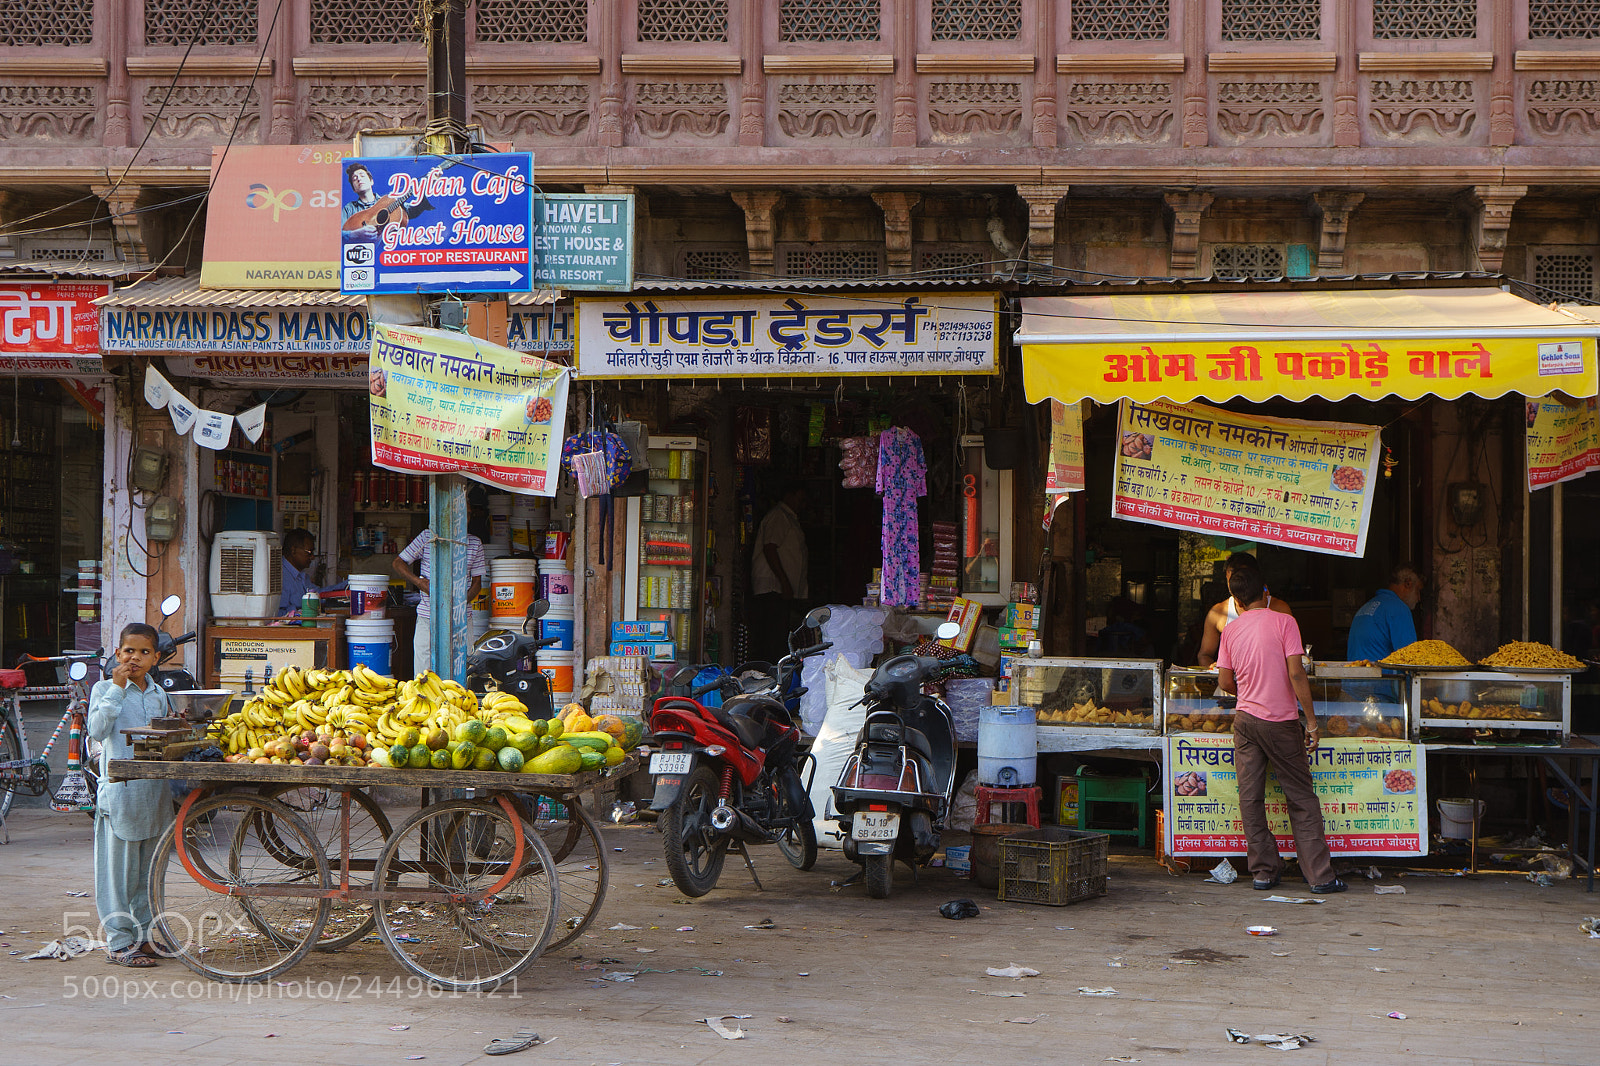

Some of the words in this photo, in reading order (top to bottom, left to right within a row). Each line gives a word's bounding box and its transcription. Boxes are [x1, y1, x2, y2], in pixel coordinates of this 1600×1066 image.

[388, 167, 467, 206] Dylan
[471, 165, 526, 204] Cafe
[451, 199, 473, 219] &
[545, 203, 618, 224] HAVELI
[382, 222, 446, 251] Guest
[449, 217, 525, 246] House
[581, 225, 592, 234] AS
[534, 236, 559, 250] EST
[564, 237, 610, 251] HOUSE
[613, 237, 624, 251] &
[384, 252, 416, 264] ROOF
[421, 252, 443, 263] TOP
[446, 251, 527, 263] RESTAURANT
[544, 255, 618, 266] RESTAURANT
[246, 270, 304, 280] NARAYAN
[307, 270, 333, 280] DAS
[534, 270, 556, 280] AGA
[560, 270, 603, 281] RESORT
[107, 311, 207, 340] NARAYAN
[212, 311, 271, 341] DASS
[769, 297, 928, 351] ट्रेडर्स
[106, 340, 117, 348] 17
[120, 340, 137, 348] PAL
[138, 340, 164, 348] HOUSE
[166, 341, 217, 350] GULABSAGAR
[286, 341, 303, 350] ALL
[304, 341, 331, 350] KINDS
[333, 341, 345, 350] OF
[736, 348, 748, 366] के
[844, 351, 867, 364] पाल
[1103, 346, 1198, 383] ओम
[1206, 346, 1264, 382] जी
[1274, 342, 1390, 387] पकोड़े
[1407, 342, 1493, 379] वाले
[1129, 401, 1214, 439] सिखवाल
[1217, 422, 1289, 451] नमकीन
[1348, 443, 1367, 462] वाले
[1189, 440, 1198, 452] के
[1200, 444, 1216, 457] शुभ
[1217, 447, 1243, 460] अवसर
[1247, 452, 1258, 462] पर
[1288, 455, 1297, 468] के
[1299, 459, 1329, 472] नमकीन
[1138, 501, 1162, 517] चौकी
[1163, 505, 1174, 519] के
[1202, 515, 1221, 527] पाल
[1250, 522, 1260, 533] के
[1324, 532, 1356, 551] जोधपुर
[625, 624, 649, 633] RANI
[625, 646, 653, 656] RANI
[1393, 745, 1412, 763] वाले
[1349, 767, 1378, 780] नमकीन
[865, 818, 876, 827] RJ
[879, 818, 888, 827] 19
[858, 830, 868, 838] SB
[1387, 834, 1418, 850] जोधपुर
[1175, 836, 1201, 851] पुलिस
[1202, 835, 1227, 848] चौकी
[1228, 836, 1239, 848] के
